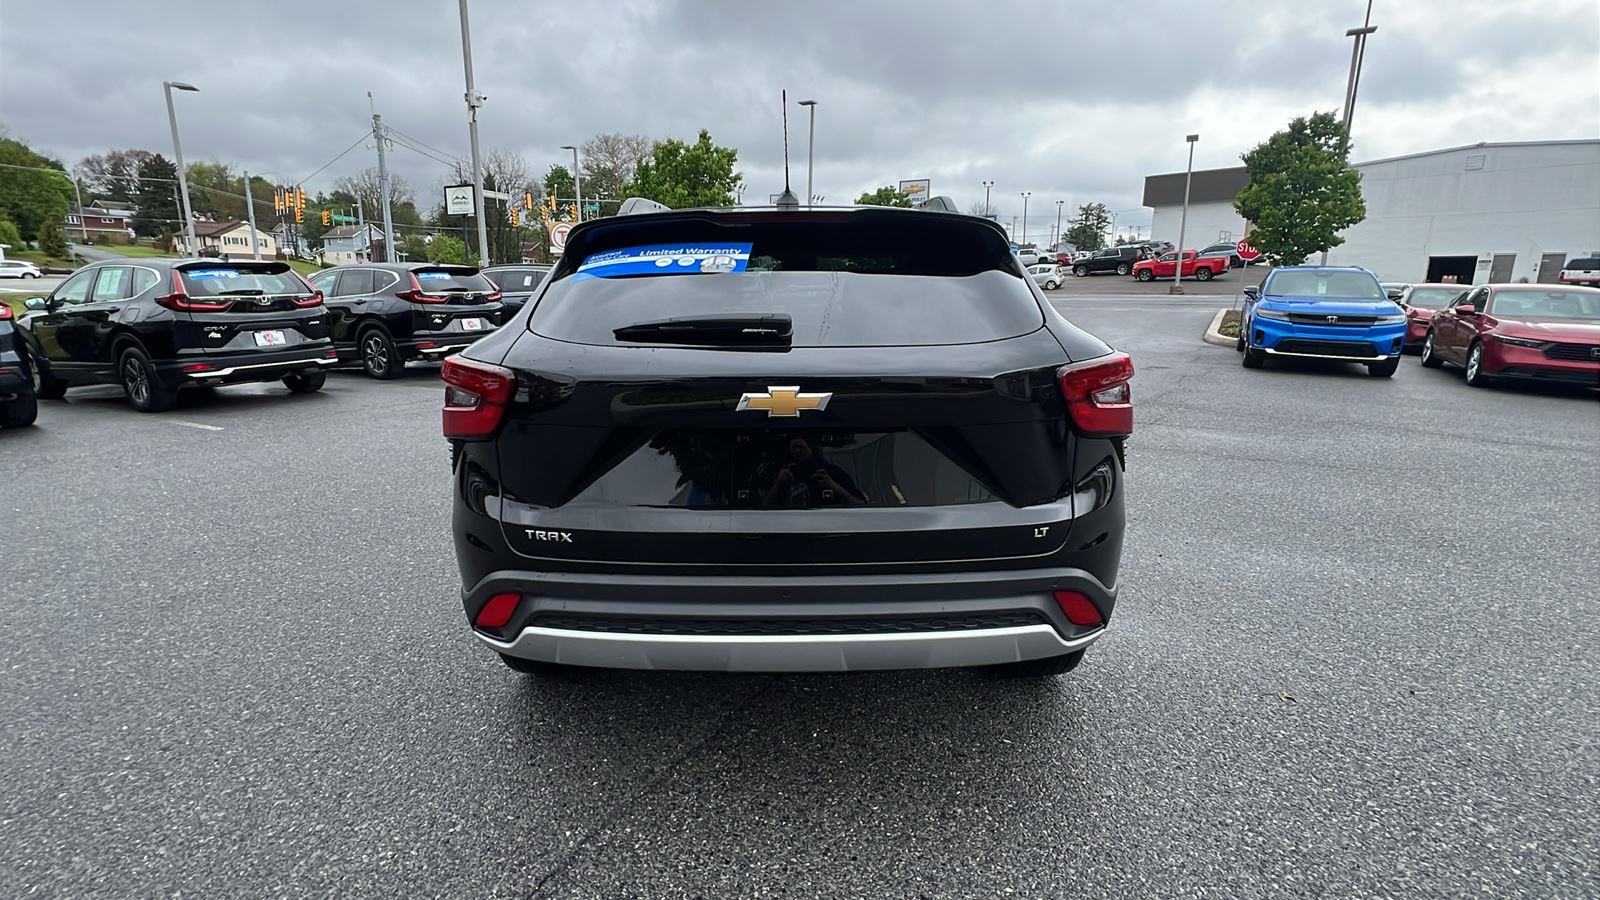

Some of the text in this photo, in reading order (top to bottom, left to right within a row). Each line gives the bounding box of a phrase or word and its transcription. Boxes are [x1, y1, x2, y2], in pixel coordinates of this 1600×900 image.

[639, 248, 742, 256] Limited Warranty
[525, 529, 573, 543] TRAX
[1034, 526, 1049, 538] LT
